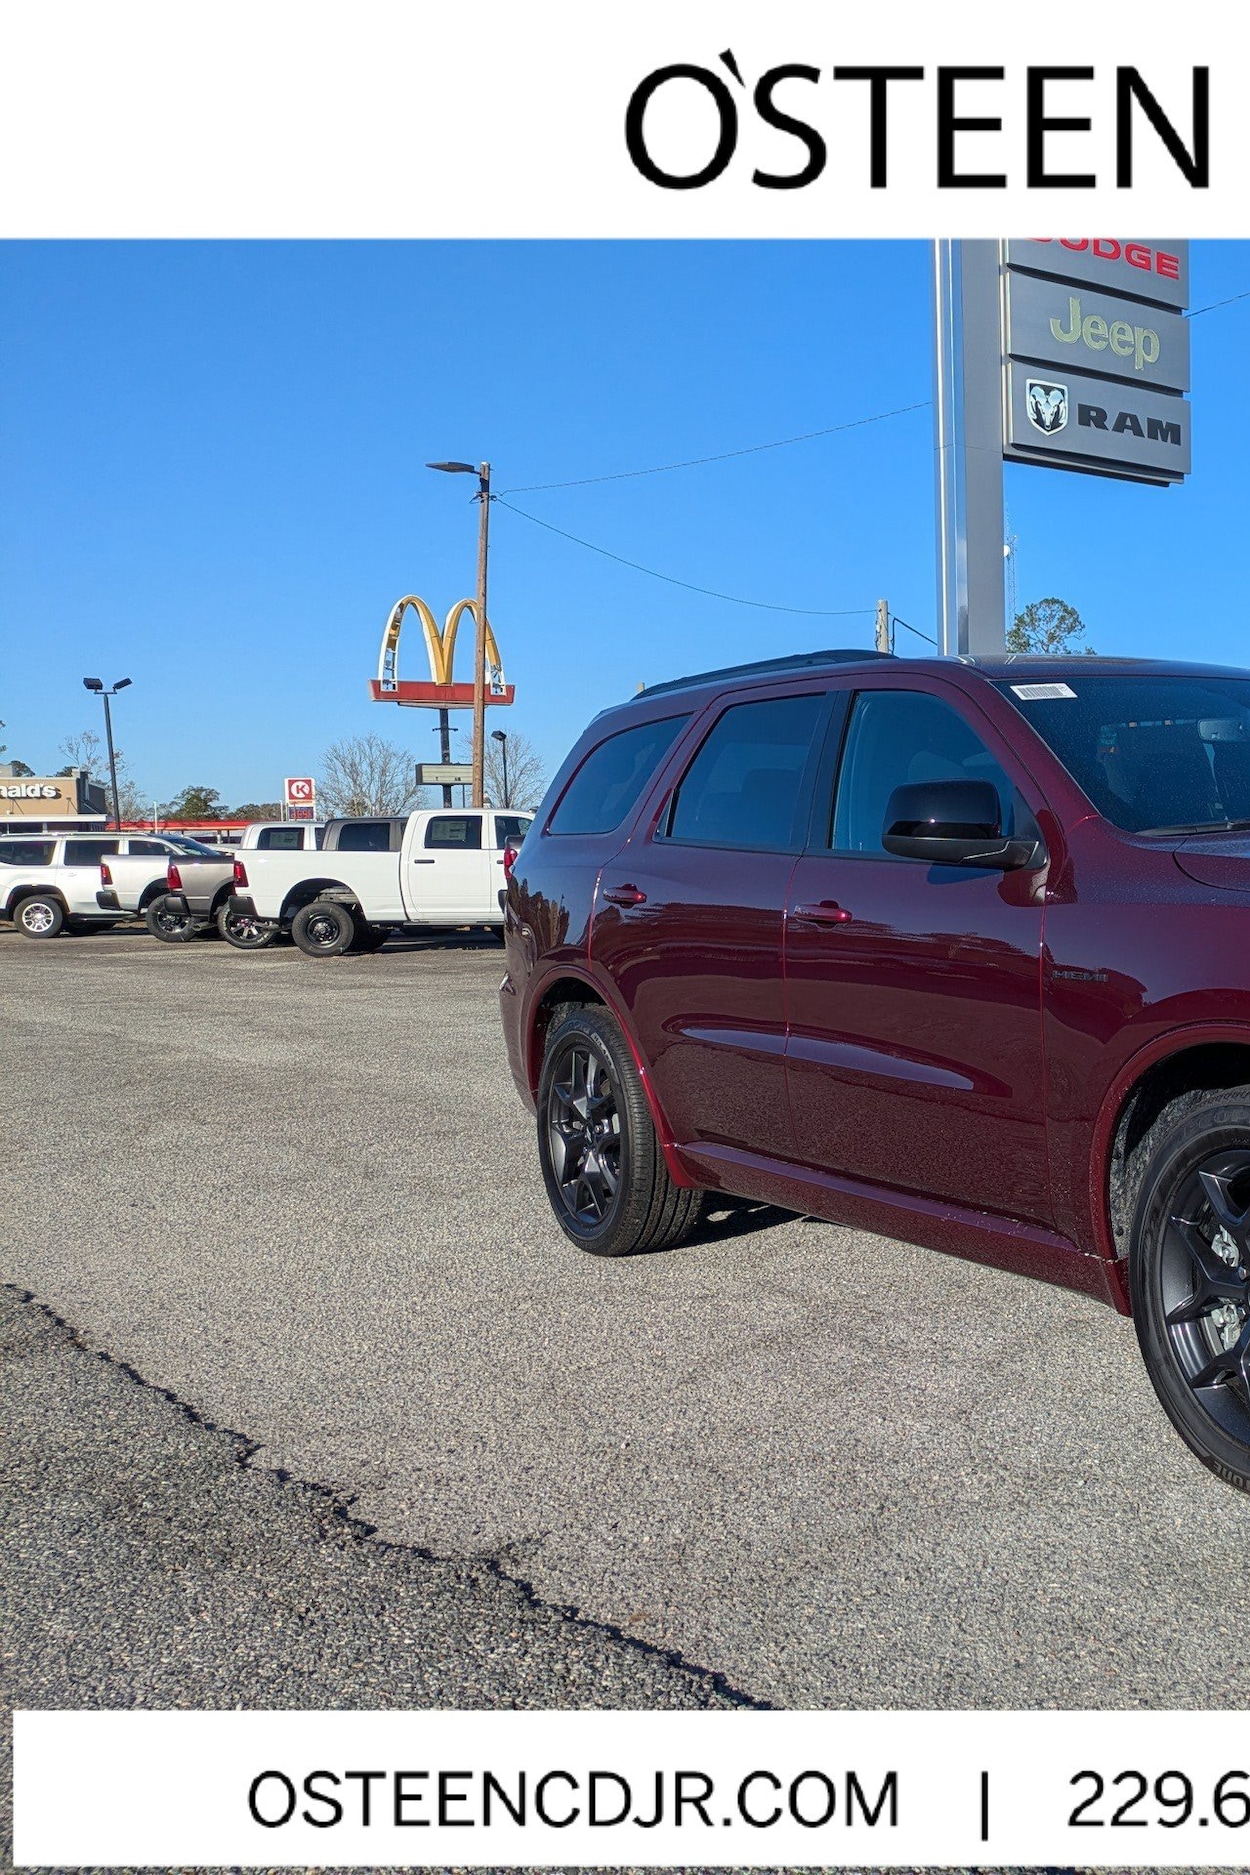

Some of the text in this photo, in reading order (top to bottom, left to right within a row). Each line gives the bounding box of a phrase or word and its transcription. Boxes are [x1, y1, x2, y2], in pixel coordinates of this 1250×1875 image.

[1025, 238, 1179, 280] ODGE
[1050, 297, 1161, 371] Jeep
[1077, 403, 1182, 446] RAM
